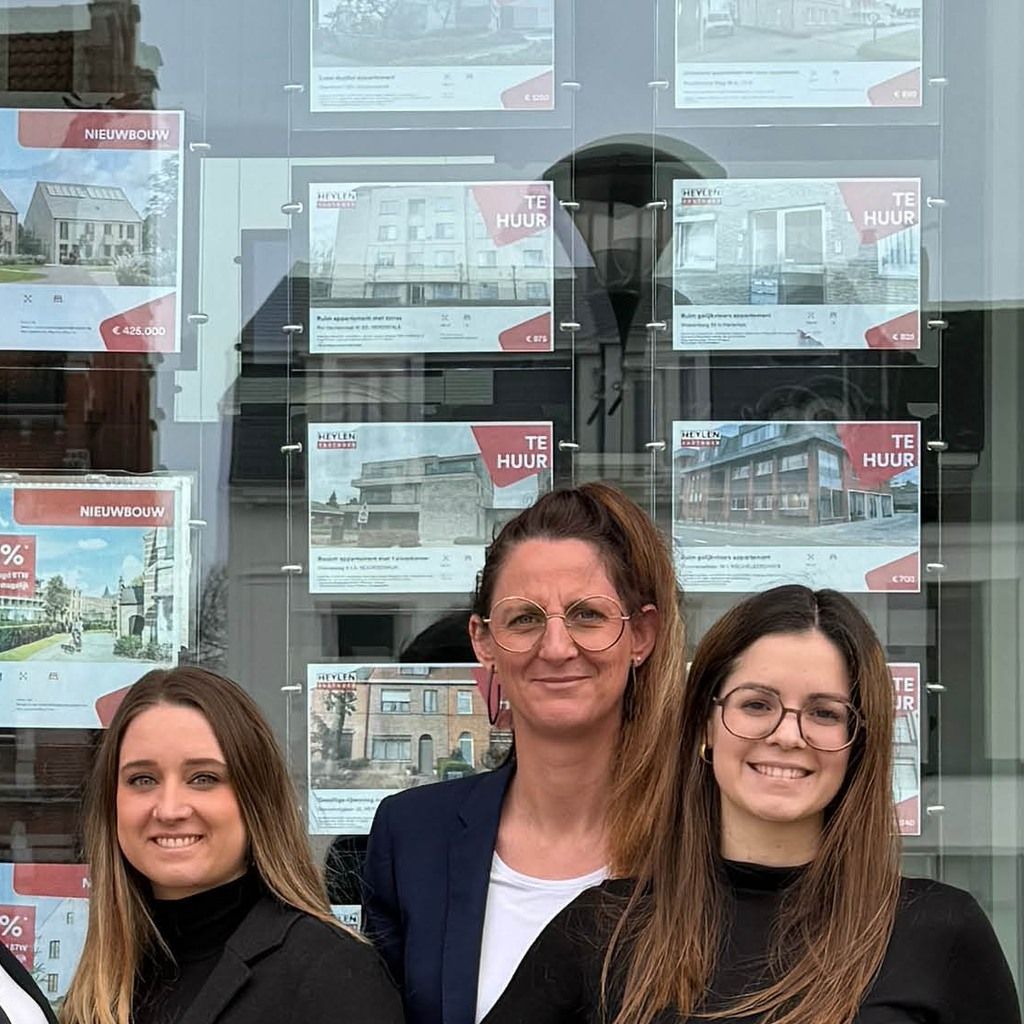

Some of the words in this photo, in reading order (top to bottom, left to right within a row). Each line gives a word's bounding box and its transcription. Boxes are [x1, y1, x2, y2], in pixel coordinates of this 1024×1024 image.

[84, 128, 170, 141] NIEUWBOUW
[523, 195, 547, 209] TE
[892, 191, 915, 207] TE
[496, 213, 547, 228] HUUR
[863, 210, 915, 225] HUUR
[113, 325, 121, 336] €
[122, 326, 166, 336] 425.000
[317, 432, 356, 441] HEYLEN
[681, 430, 721, 439] HEYLEN
[891, 434, 914, 449] TE
[525, 435, 548, 450] TE
[497, 454, 548, 469] HUUR
[863, 452, 914, 467] HUUR
[79, 505, 165, 518] NIEUWBOUW
[318, 673, 356, 681] HEYLEN
[892, 677, 914, 692] TE
